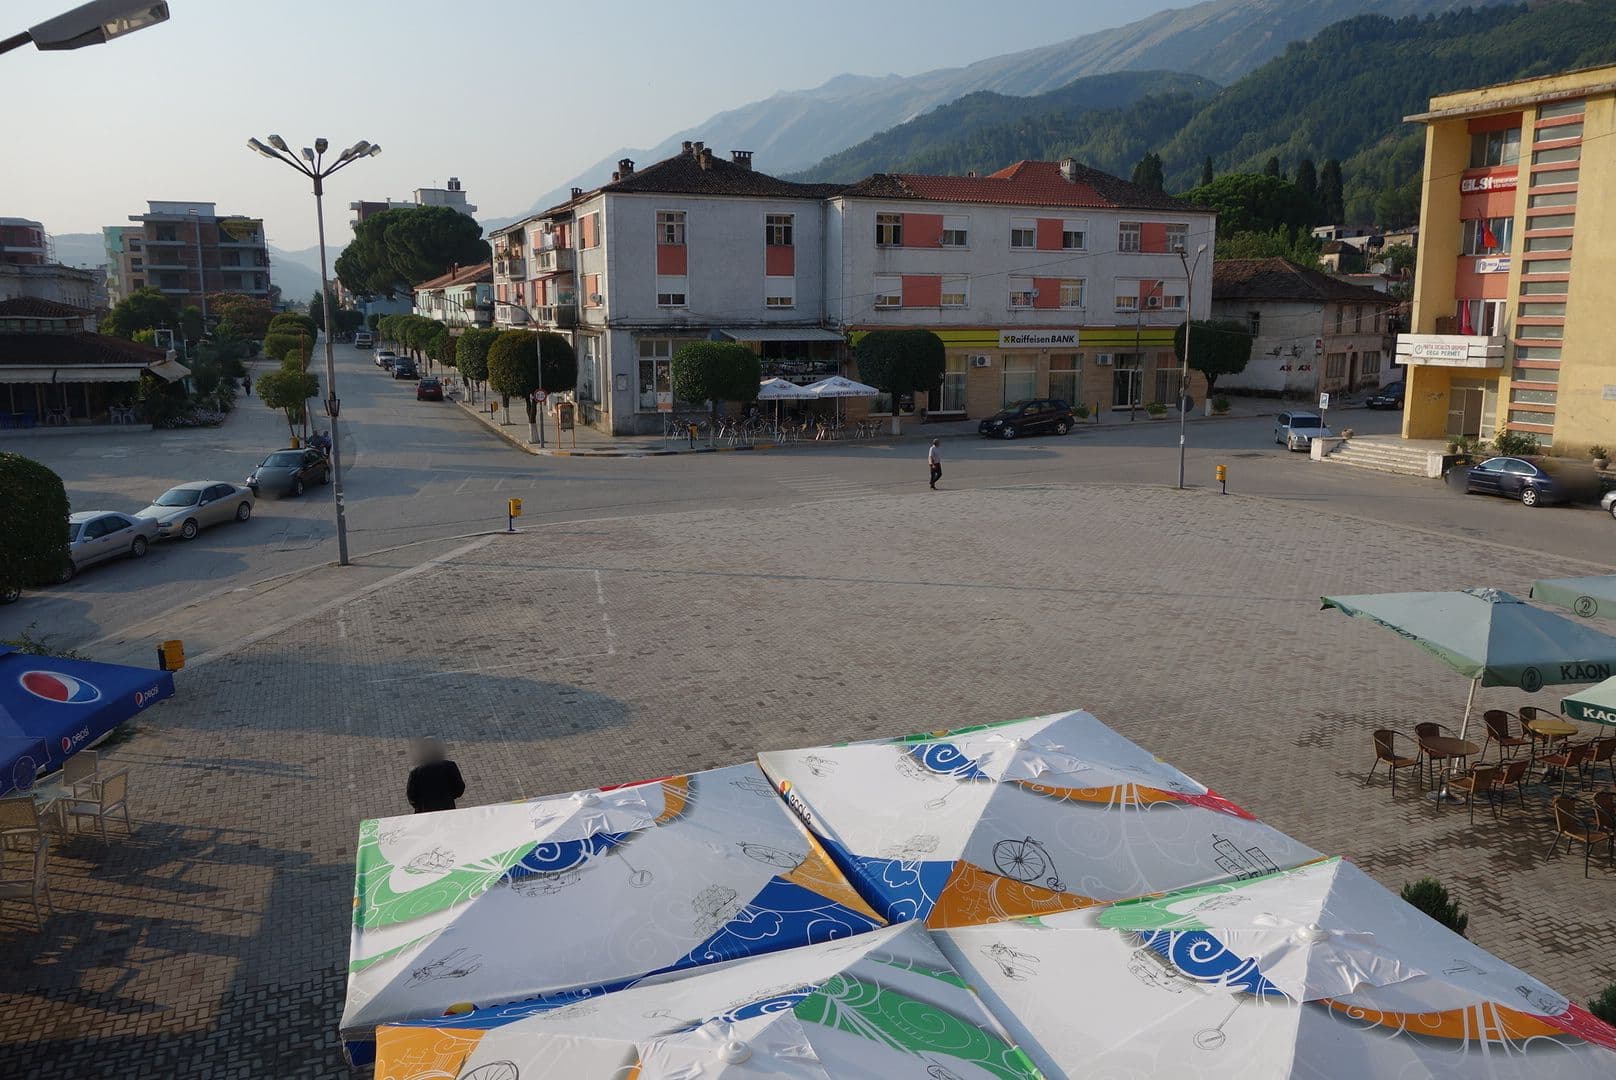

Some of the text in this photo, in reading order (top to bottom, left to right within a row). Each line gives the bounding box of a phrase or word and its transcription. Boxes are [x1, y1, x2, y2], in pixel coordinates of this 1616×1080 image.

[1560, 663, 1610, 681] KAON
[143, 685, 159, 702] pepsi
[71, 727, 90, 748] pepsi
